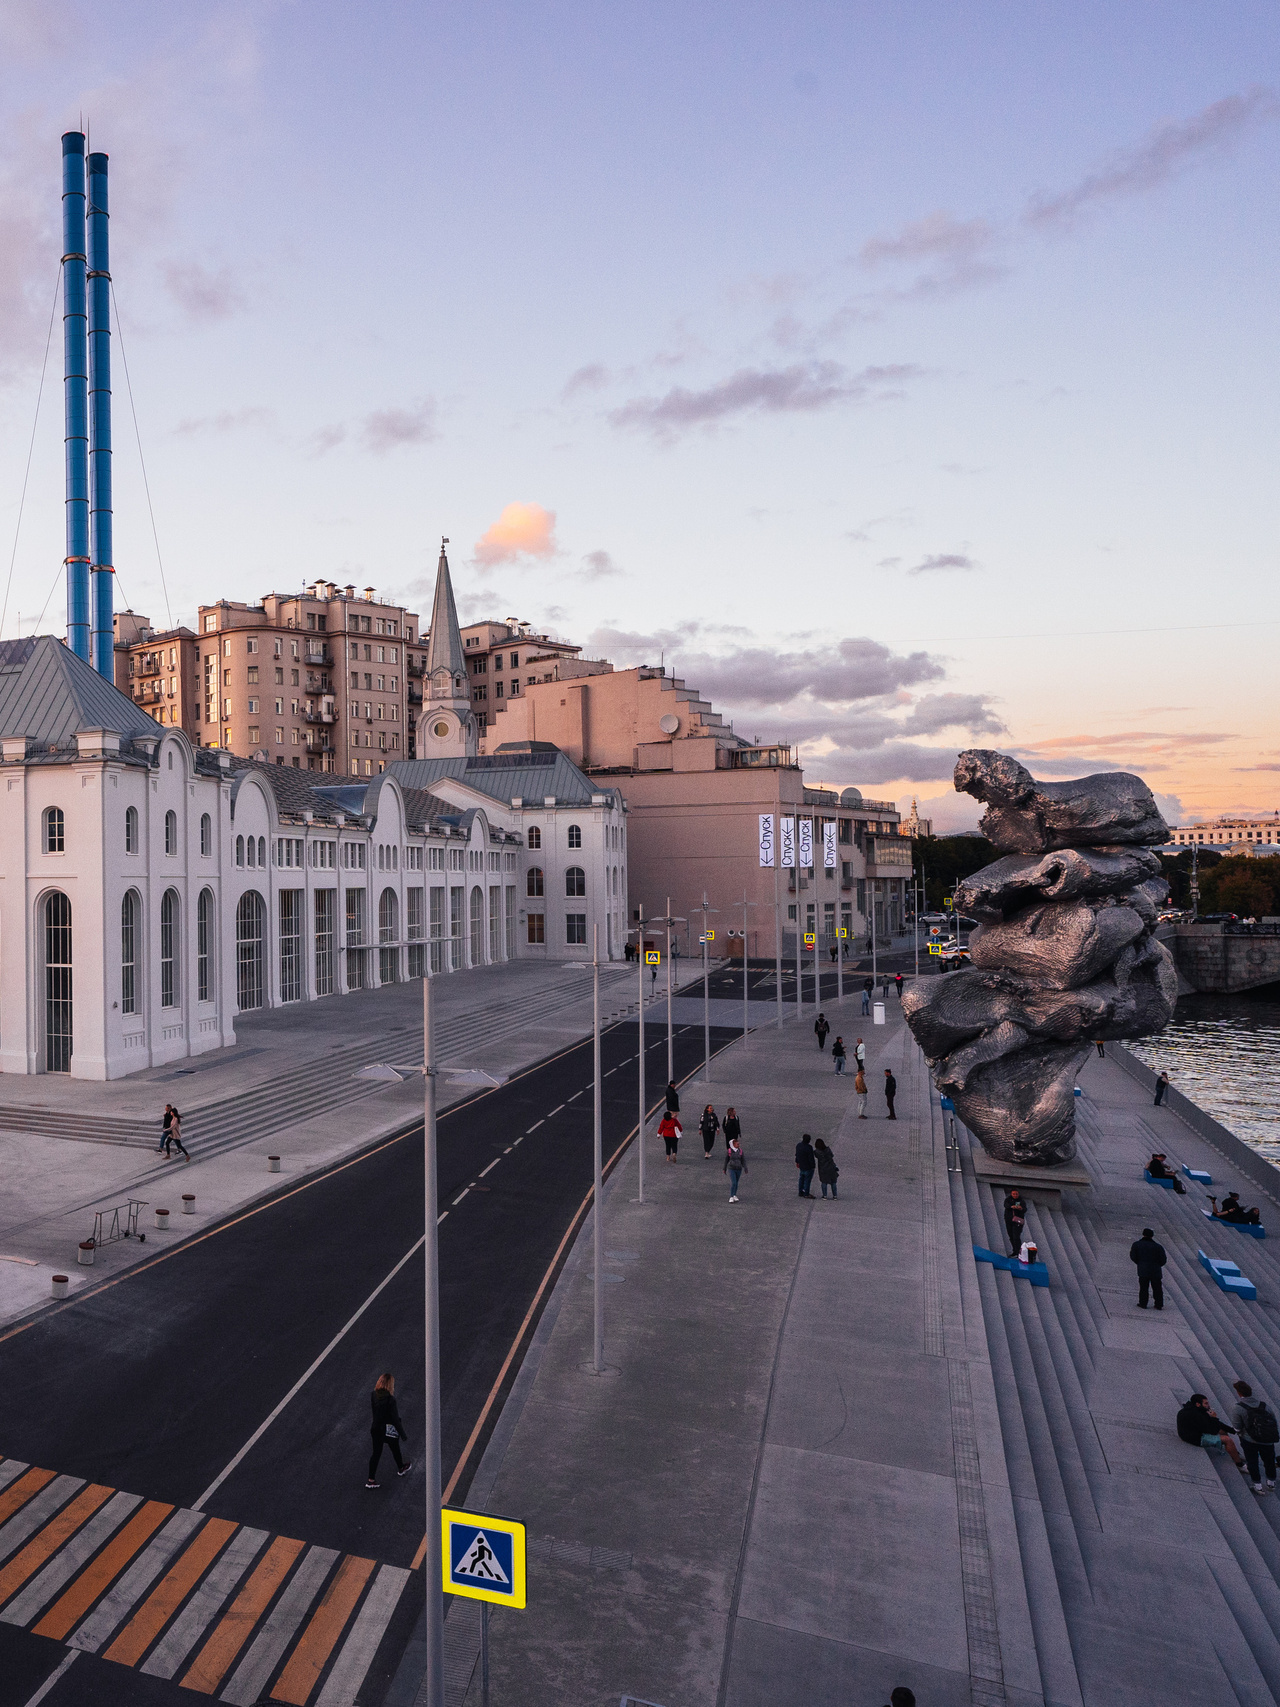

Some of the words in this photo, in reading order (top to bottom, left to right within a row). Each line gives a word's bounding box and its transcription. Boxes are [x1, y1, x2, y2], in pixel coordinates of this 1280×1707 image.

[760, 816, 773, 850] Спуск
[800, 822, 811, 852] Спуск
[782, 834, 794, 866] Спуск
[824, 837, 836, 866] Спуск
